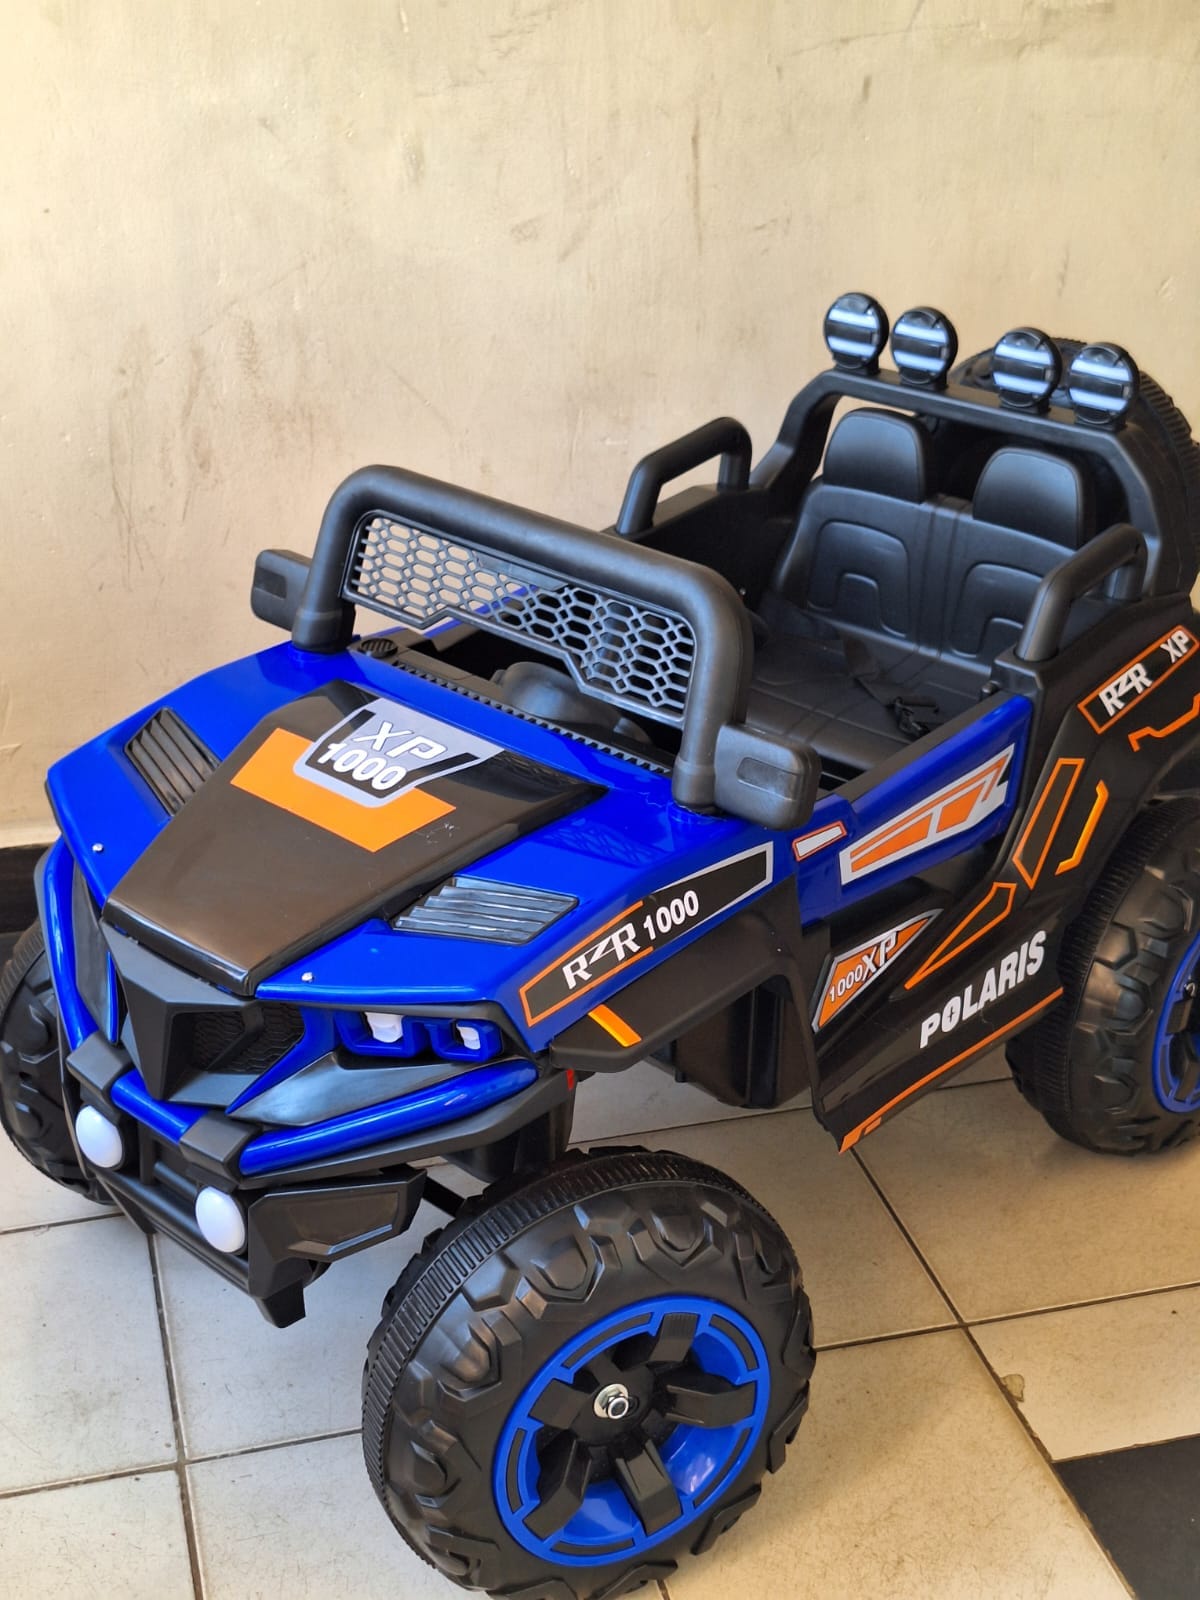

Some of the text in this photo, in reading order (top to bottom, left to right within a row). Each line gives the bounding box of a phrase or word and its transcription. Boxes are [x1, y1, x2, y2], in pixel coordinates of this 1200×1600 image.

[1098, 630, 1190, 717] RZR XP
[317, 742, 407, 791] 1000
[352, 721, 448, 761] XP
[562, 890, 700, 990] RZR 1000
[919, 930, 1047, 1049] POLARIS
